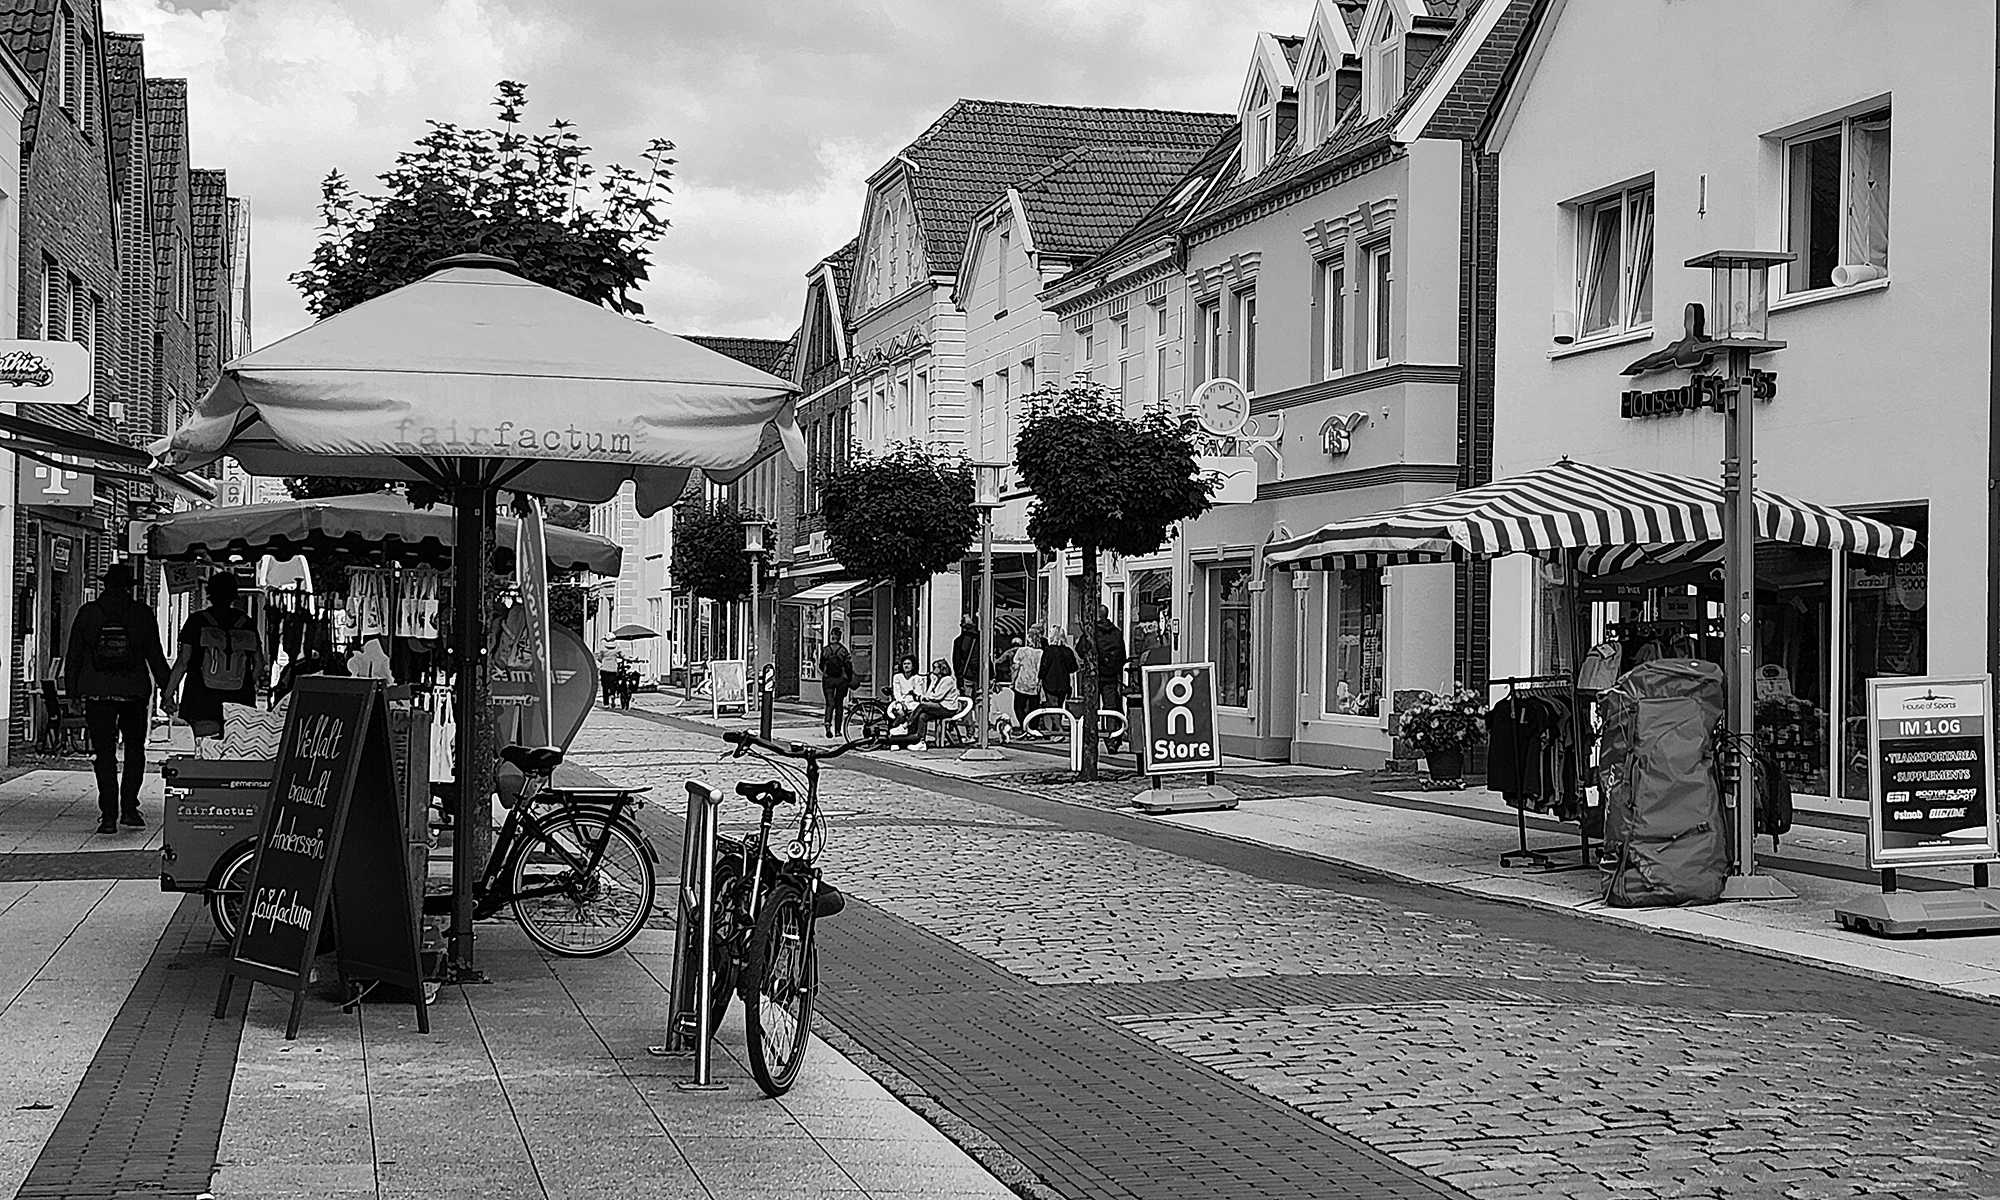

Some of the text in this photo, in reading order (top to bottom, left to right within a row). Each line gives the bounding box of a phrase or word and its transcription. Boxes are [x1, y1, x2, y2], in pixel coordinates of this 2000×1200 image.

[393, 416, 633, 454] fairfactum
[1933, 702, 1957, 711] Sports
[1900, 721, 1920, 736] IM
[294, 714, 344, 782] Vielfalt
[1154, 739, 1211, 760] Store
[288, 770, 332, 808] braucht
[177, 804, 255, 817] fairfactum
[269, 806, 325, 860] Anderssein
[248, 887, 312, 936] fairfactum
